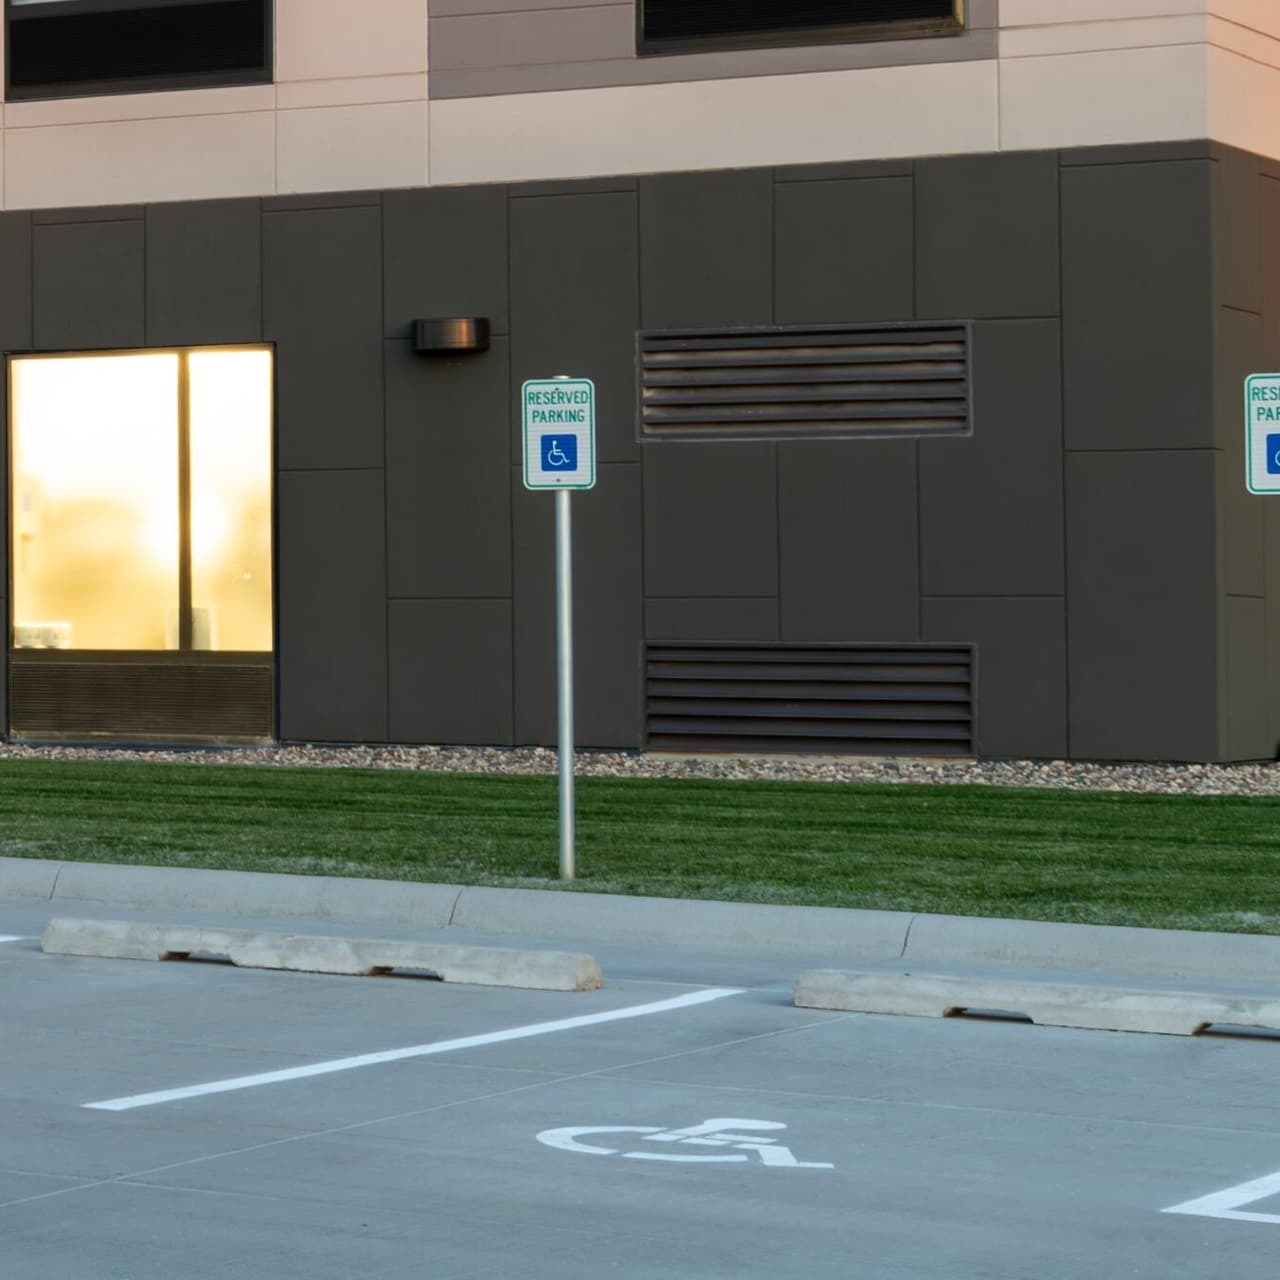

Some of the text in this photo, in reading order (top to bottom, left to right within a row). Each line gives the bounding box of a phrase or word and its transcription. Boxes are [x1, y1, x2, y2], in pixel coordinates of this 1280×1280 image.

[528, 390, 588, 405] RESERVED
[1252, 386, 1280, 401] RES
[532, 409, 585, 423] PARKING
